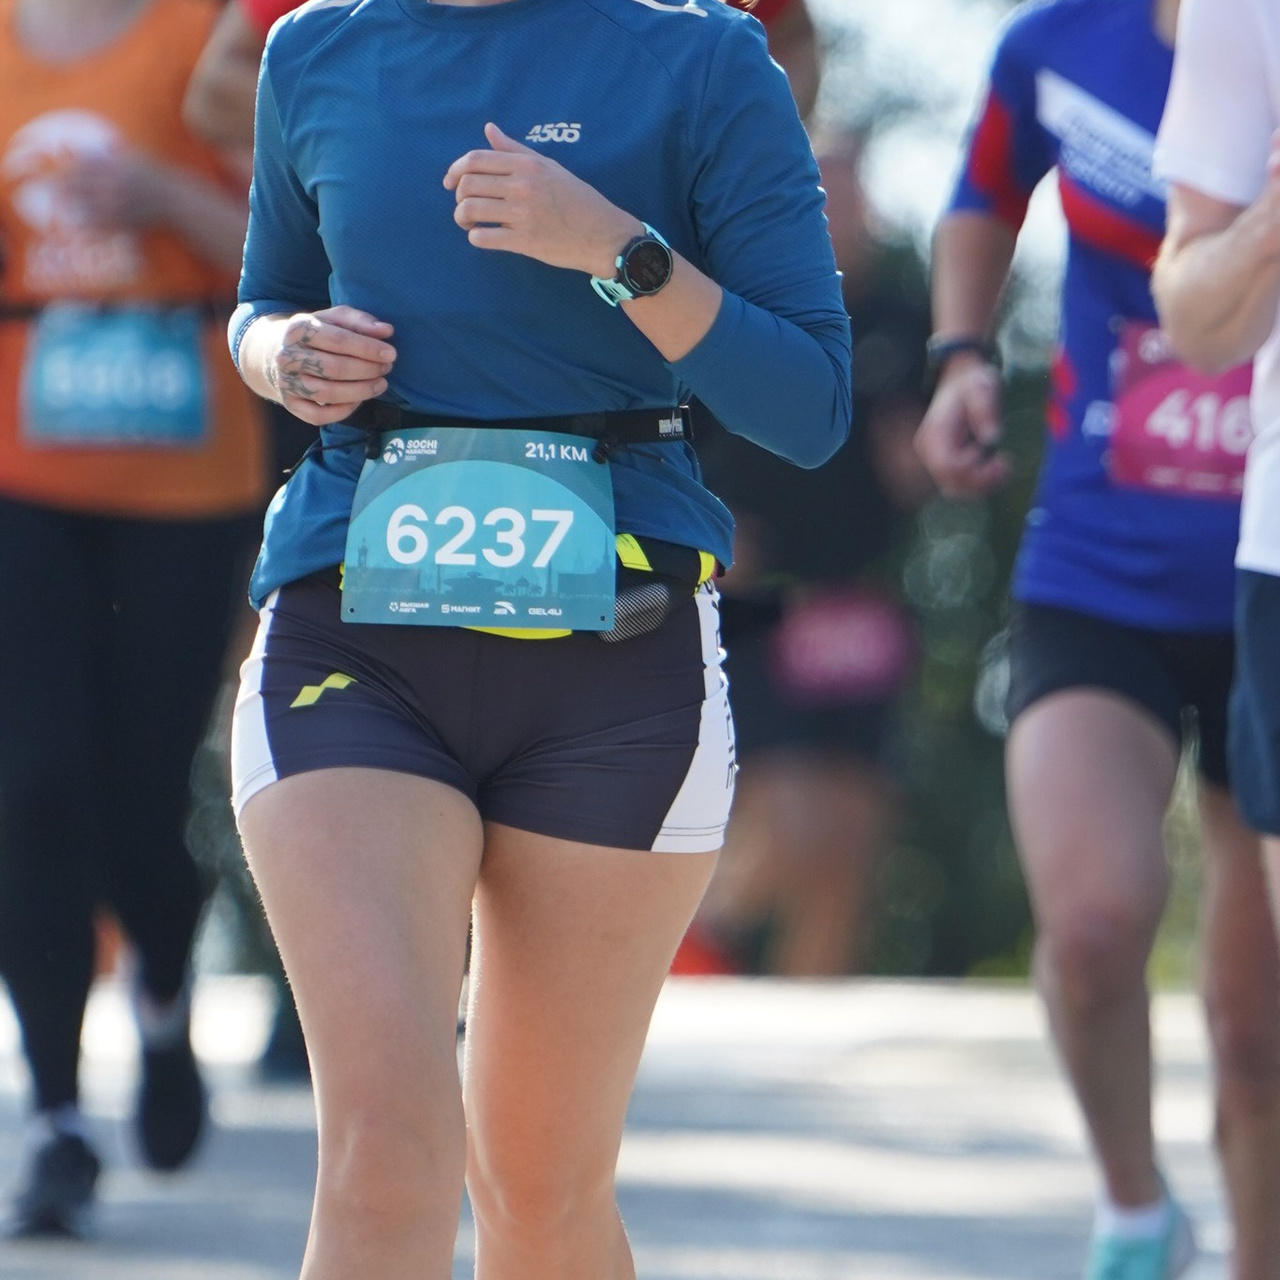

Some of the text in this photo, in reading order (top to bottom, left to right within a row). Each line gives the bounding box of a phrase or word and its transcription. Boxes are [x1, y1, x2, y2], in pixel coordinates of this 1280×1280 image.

[1145, 388, 1252, 456] 416
[406, 439, 438, 449] SOCHI
[525, 442, 588, 462] 21,1 KM
[386, 503, 574, 568] 6237
[450, 605, 481, 614] МАГНИТ
